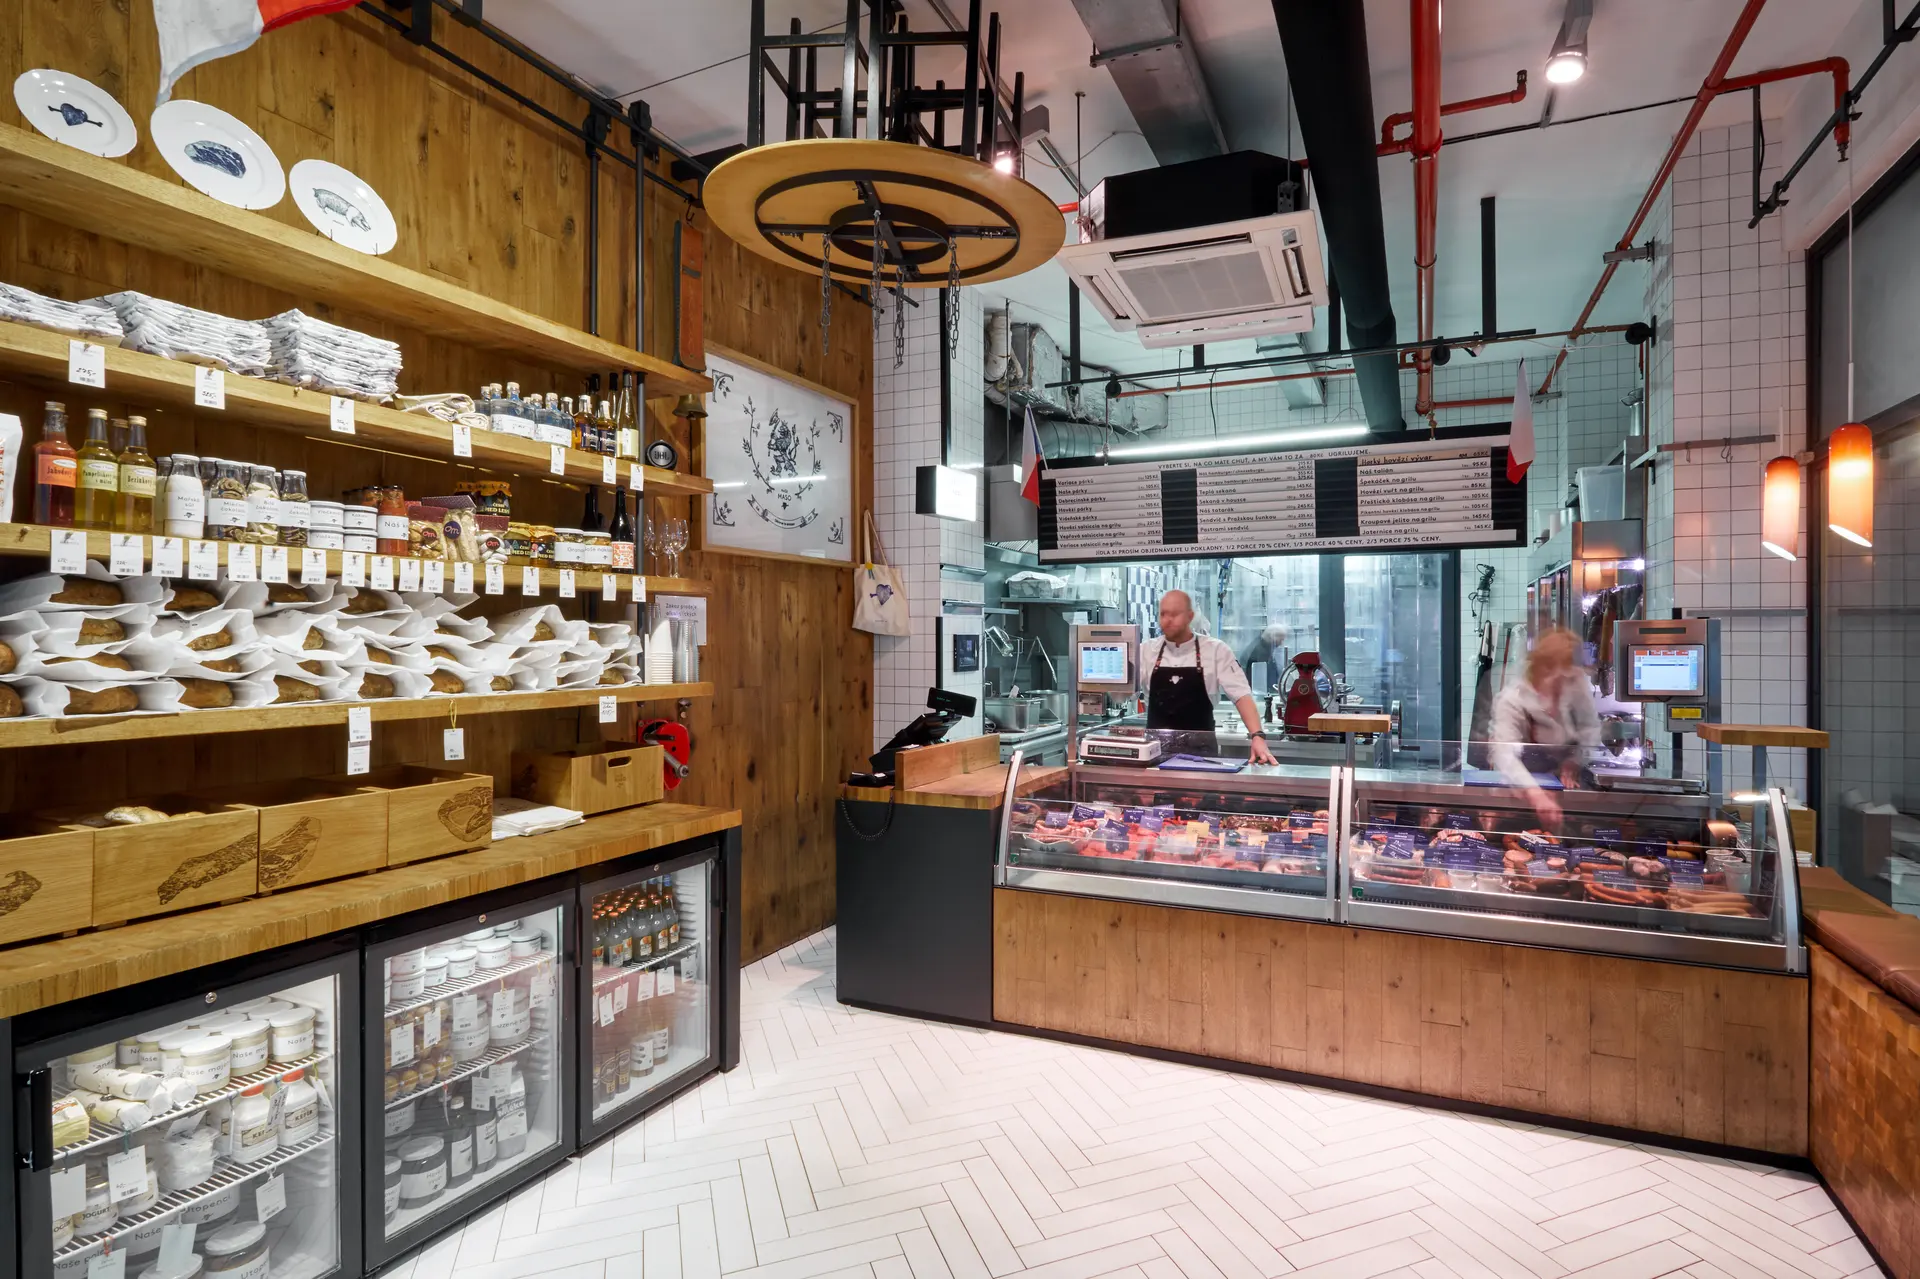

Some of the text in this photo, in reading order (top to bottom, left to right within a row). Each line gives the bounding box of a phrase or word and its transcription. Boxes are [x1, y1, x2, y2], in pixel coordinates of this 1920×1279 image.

[654, 451, 670, 461] JBL
[1410, 454, 1433, 462] vývar
[1401, 476, 1416, 484] grilu
[777, 493, 792, 502] MASO
[1392, 516, 1410, 524] jelito
[1421, 515, 1437, 523] grilu
[82, 1206, 111, 1220] JOGURT
[134, 1227, 162, 1241] Naše
